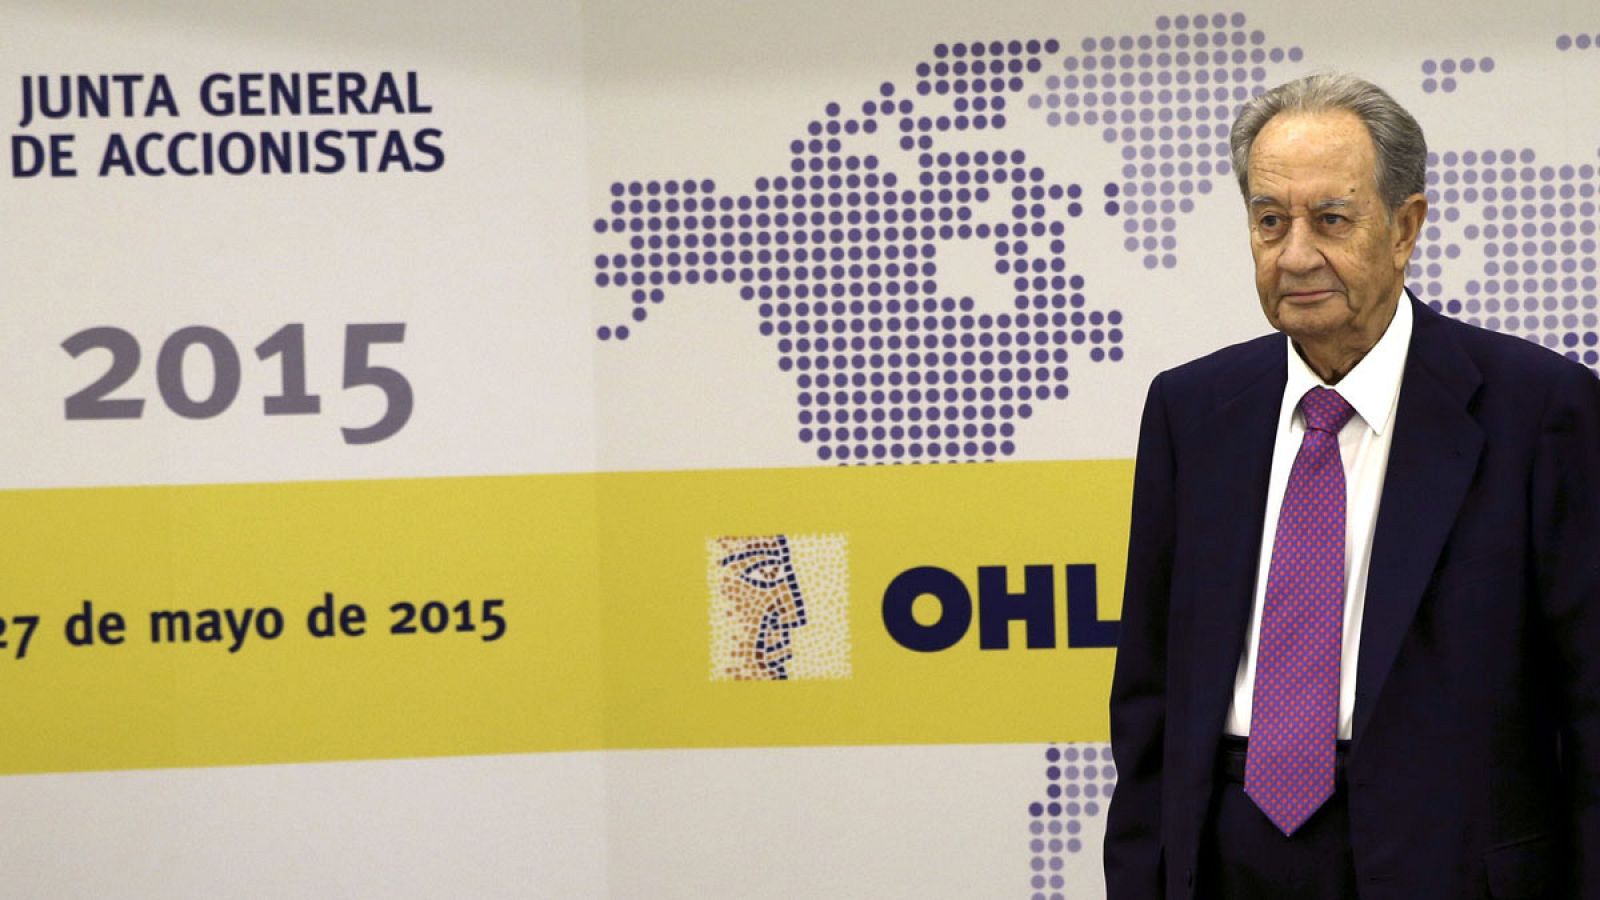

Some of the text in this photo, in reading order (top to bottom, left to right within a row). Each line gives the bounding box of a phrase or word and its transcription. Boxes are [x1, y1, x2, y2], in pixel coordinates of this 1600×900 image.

[20, 72, 432, 127] JUNTA GENERAL
[11, 128, 445, 178] DE ACCIONISTAS
[60, 323, 414, 444] 2015
[0, 593, 507, 659] 7 de mayo de 2015
[881, 564, 1120, 652] OHL
